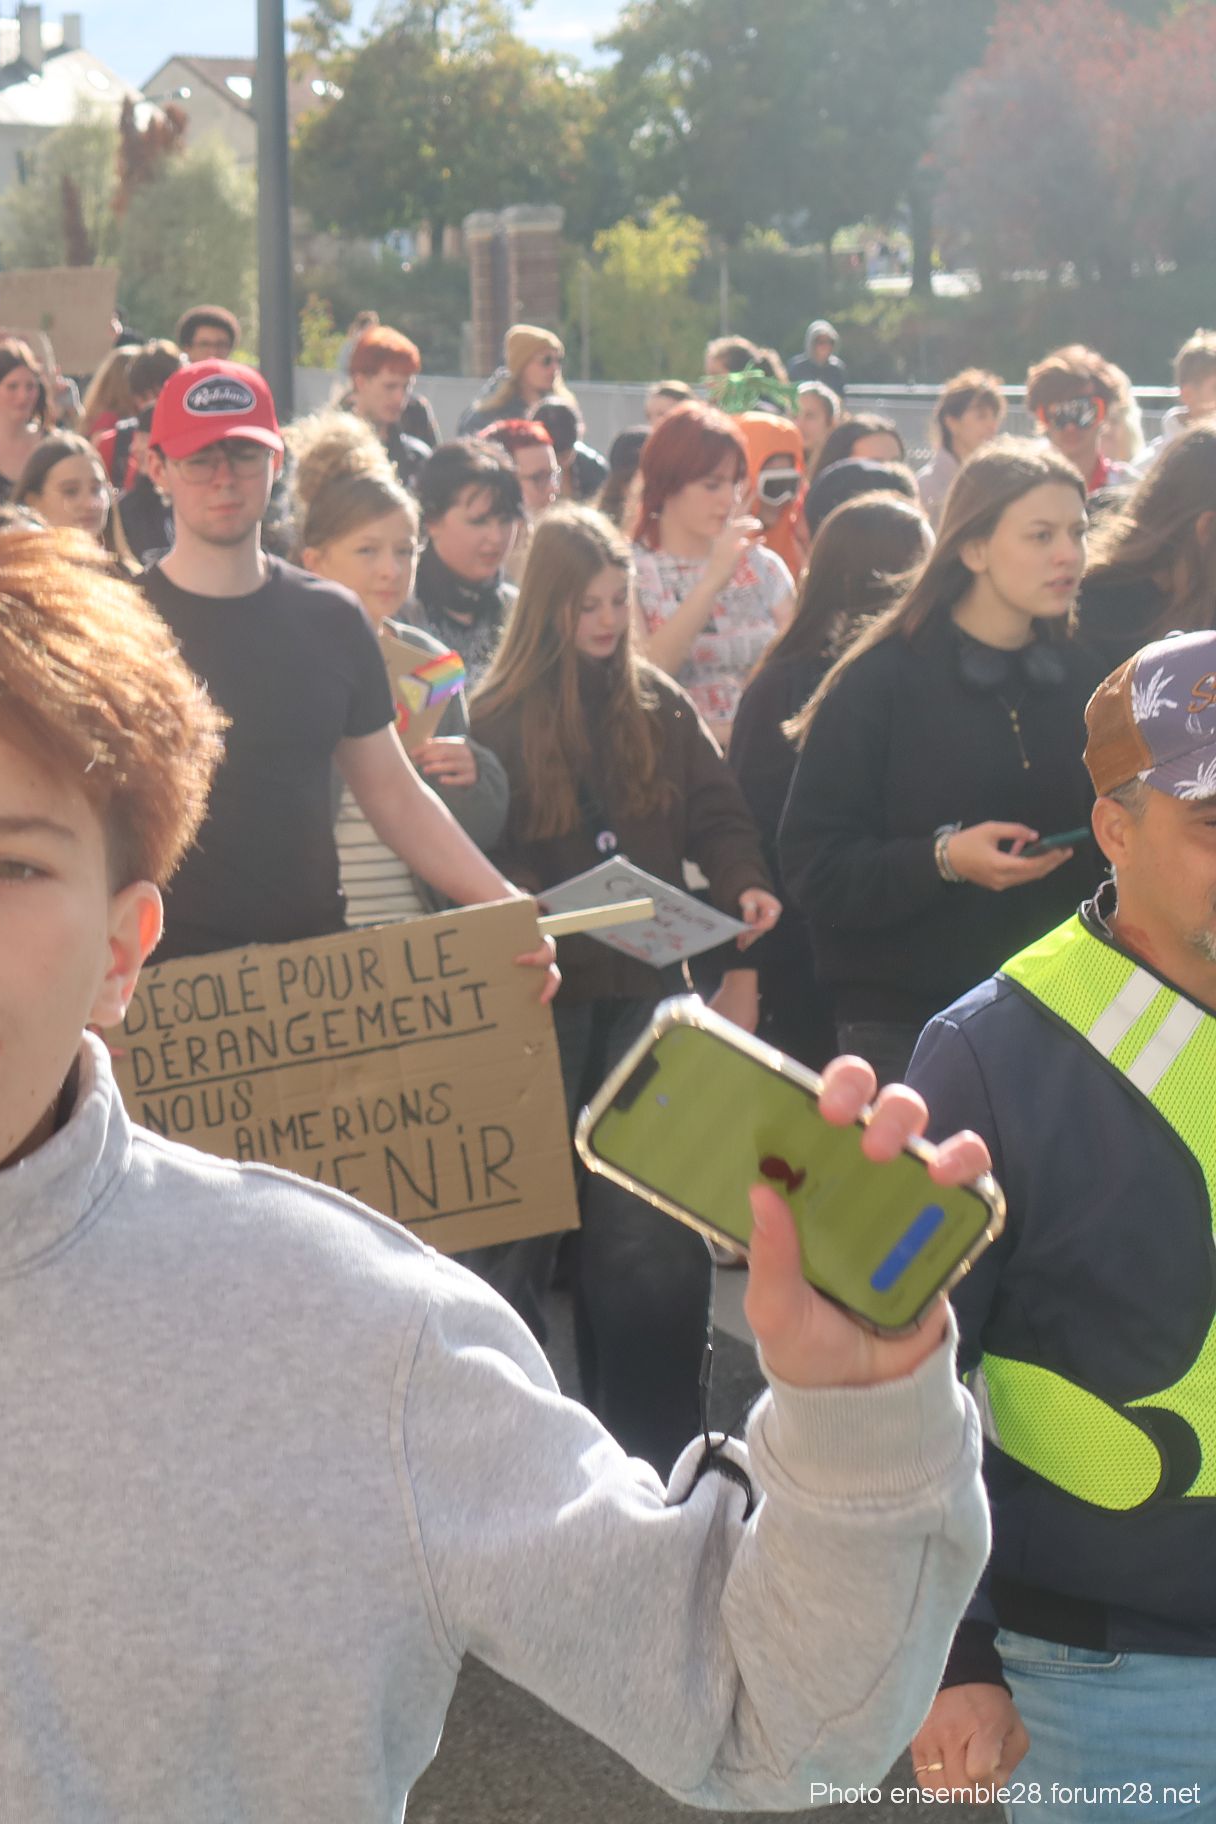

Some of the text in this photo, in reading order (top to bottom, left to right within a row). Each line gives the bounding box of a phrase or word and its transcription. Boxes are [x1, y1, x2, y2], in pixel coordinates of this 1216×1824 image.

[123, 928, 469, 1036] DÉSOLÉ POUR LE
[131, 982, 488, 1088] DÉRANGEMENT
[141, 1078, 254, 1137] NOUS
